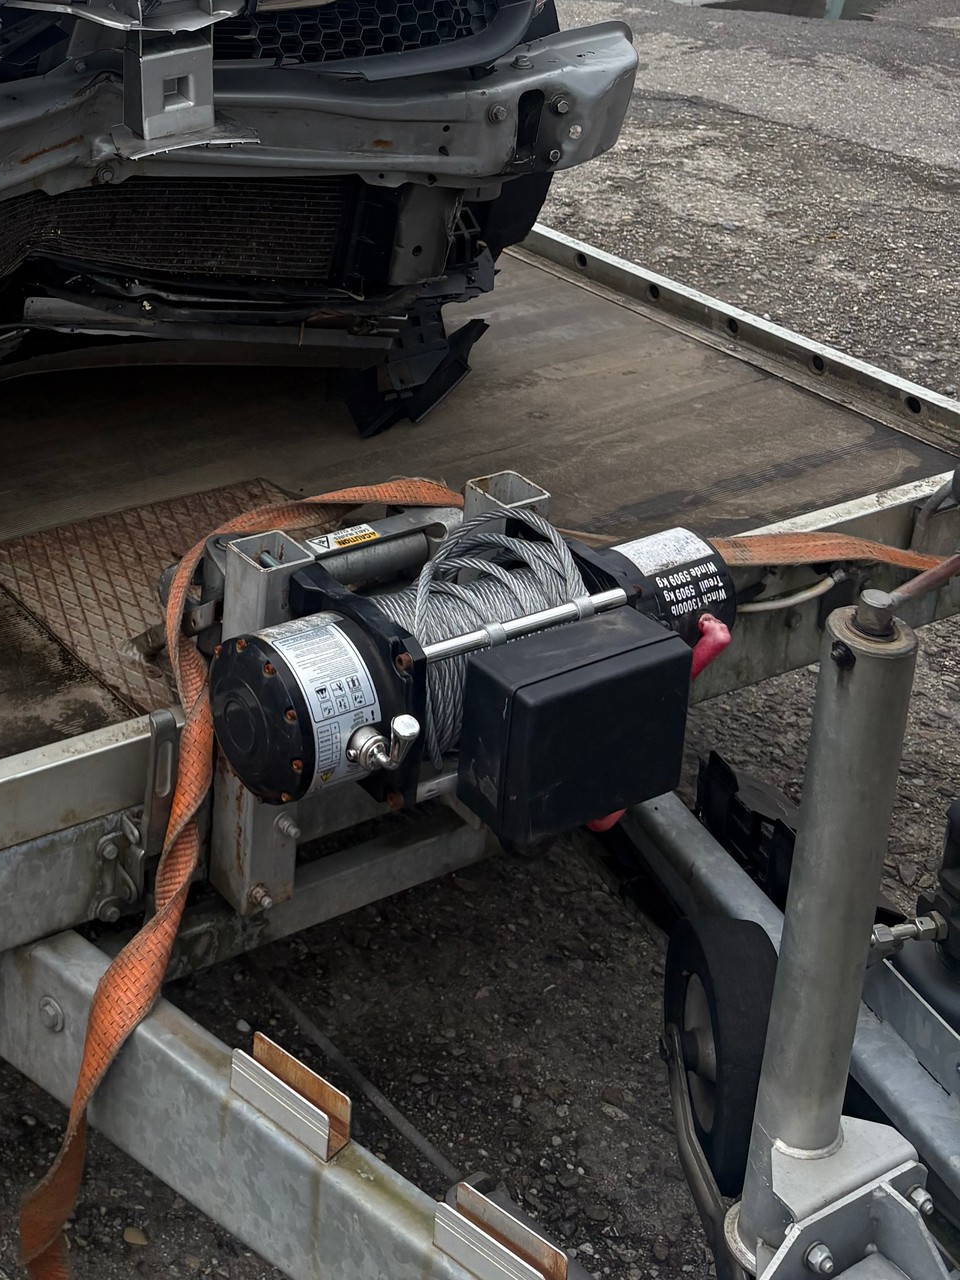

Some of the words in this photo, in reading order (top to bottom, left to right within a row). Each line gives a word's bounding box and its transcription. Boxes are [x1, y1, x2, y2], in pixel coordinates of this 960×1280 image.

[336, 532, 372, 546] CAUTION
[689, 561, 718, 578] Winde
[655, 576, 671, 588] kg
[668, 570, 691, 587] 5909
[698, 575, 724, 593] Treuil
[663, 590, 677, 602] kg
[675, 584, 696, 601] 5909
[702, 588, 727, 605] Winch
[670, 597, 702, 616] 13000lb
